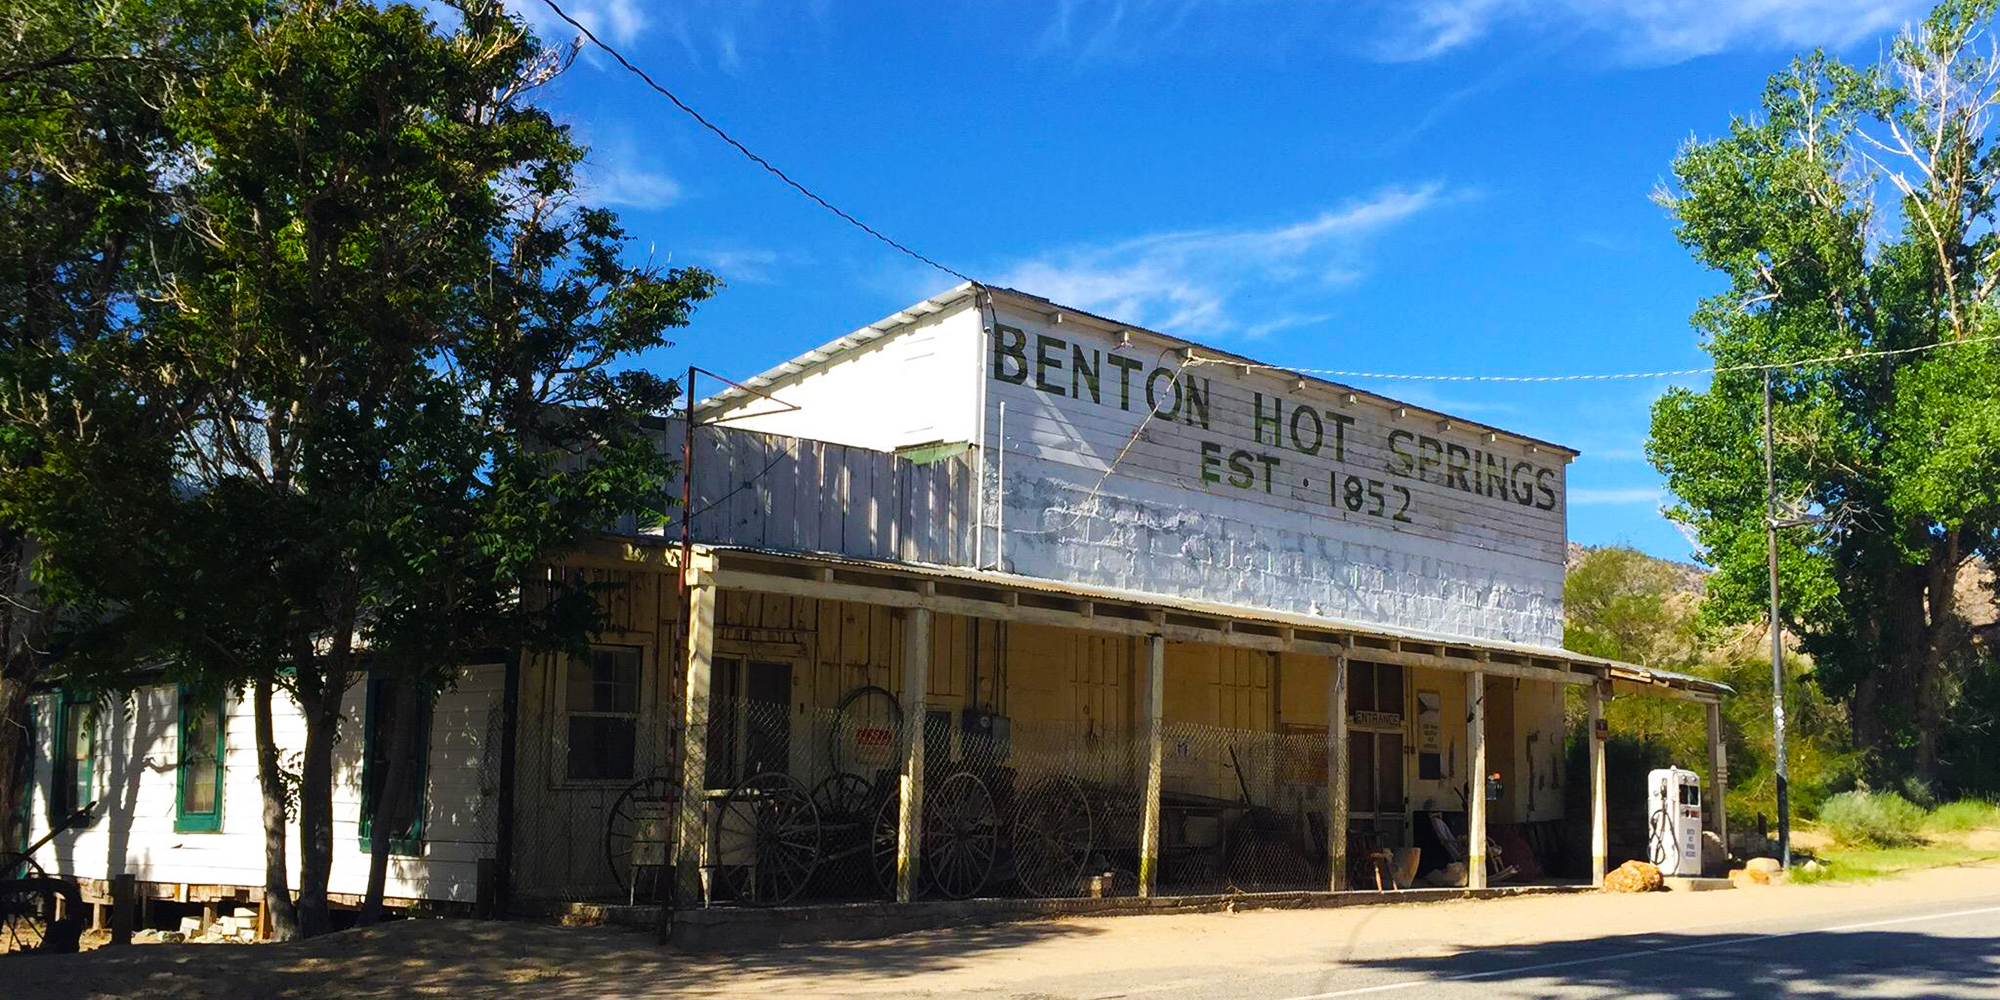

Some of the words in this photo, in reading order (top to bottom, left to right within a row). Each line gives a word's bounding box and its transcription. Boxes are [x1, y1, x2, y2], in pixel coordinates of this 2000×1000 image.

[992, 321, 1210, 431] BENTON
[1254, 392, 1355, 462] HOT
[1386, 428, 1556, 512] SPRINGS
[1330, 470, 1412, 522] 1852
[1356, 711, 1399, 726] ENTRANCE
